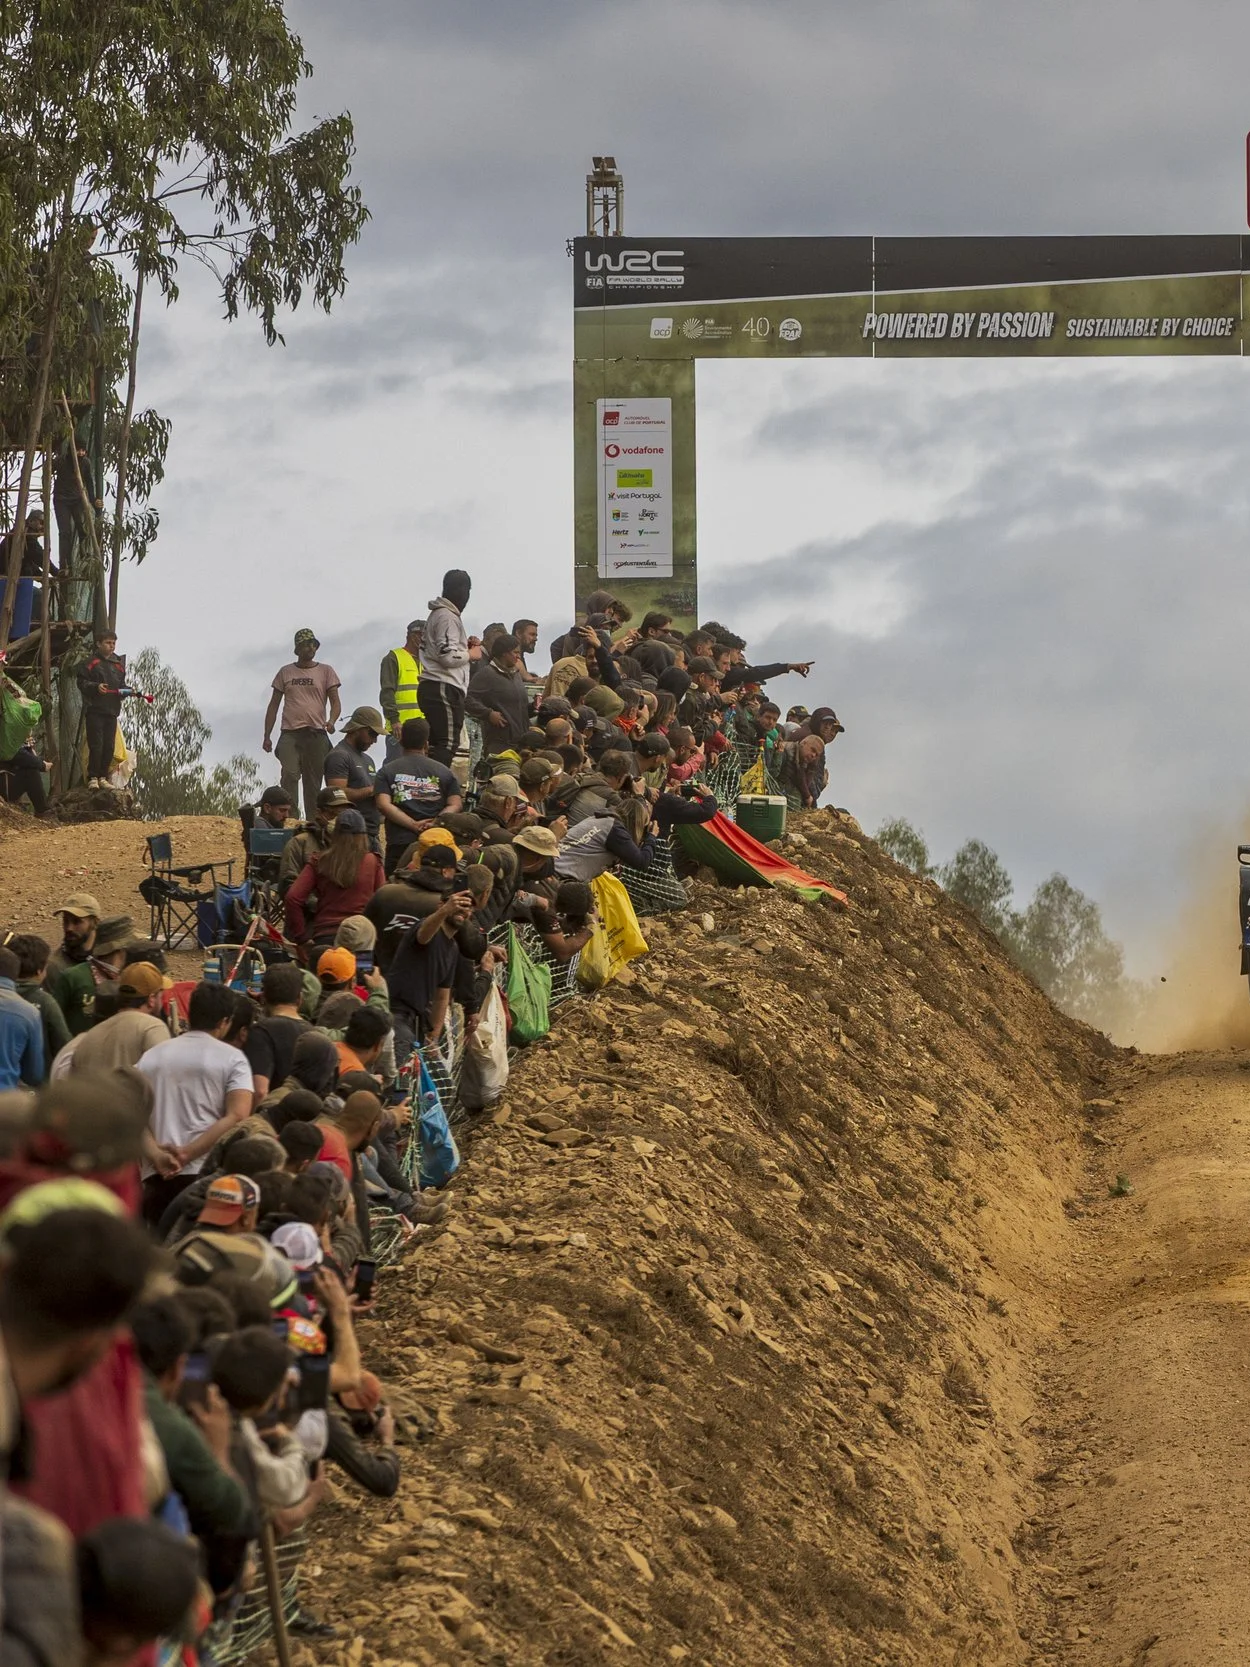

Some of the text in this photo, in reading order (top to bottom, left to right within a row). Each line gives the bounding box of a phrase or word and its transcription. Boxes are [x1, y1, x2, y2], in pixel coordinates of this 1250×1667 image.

[585, 251, 685, 271] WRC
[586, 277, 604, 287] FIA
[653, 328, 671, 337] acp
[741, 317, 770, 337] 40
[863, 311, 1055, 339] POWERED BY PASSION
[1066, 317, 1235, 338] SUSTAINABLE BY CHOICE
[622, 446, 665, 455] vodafone
[630, 492, 662, 502] Portugal
